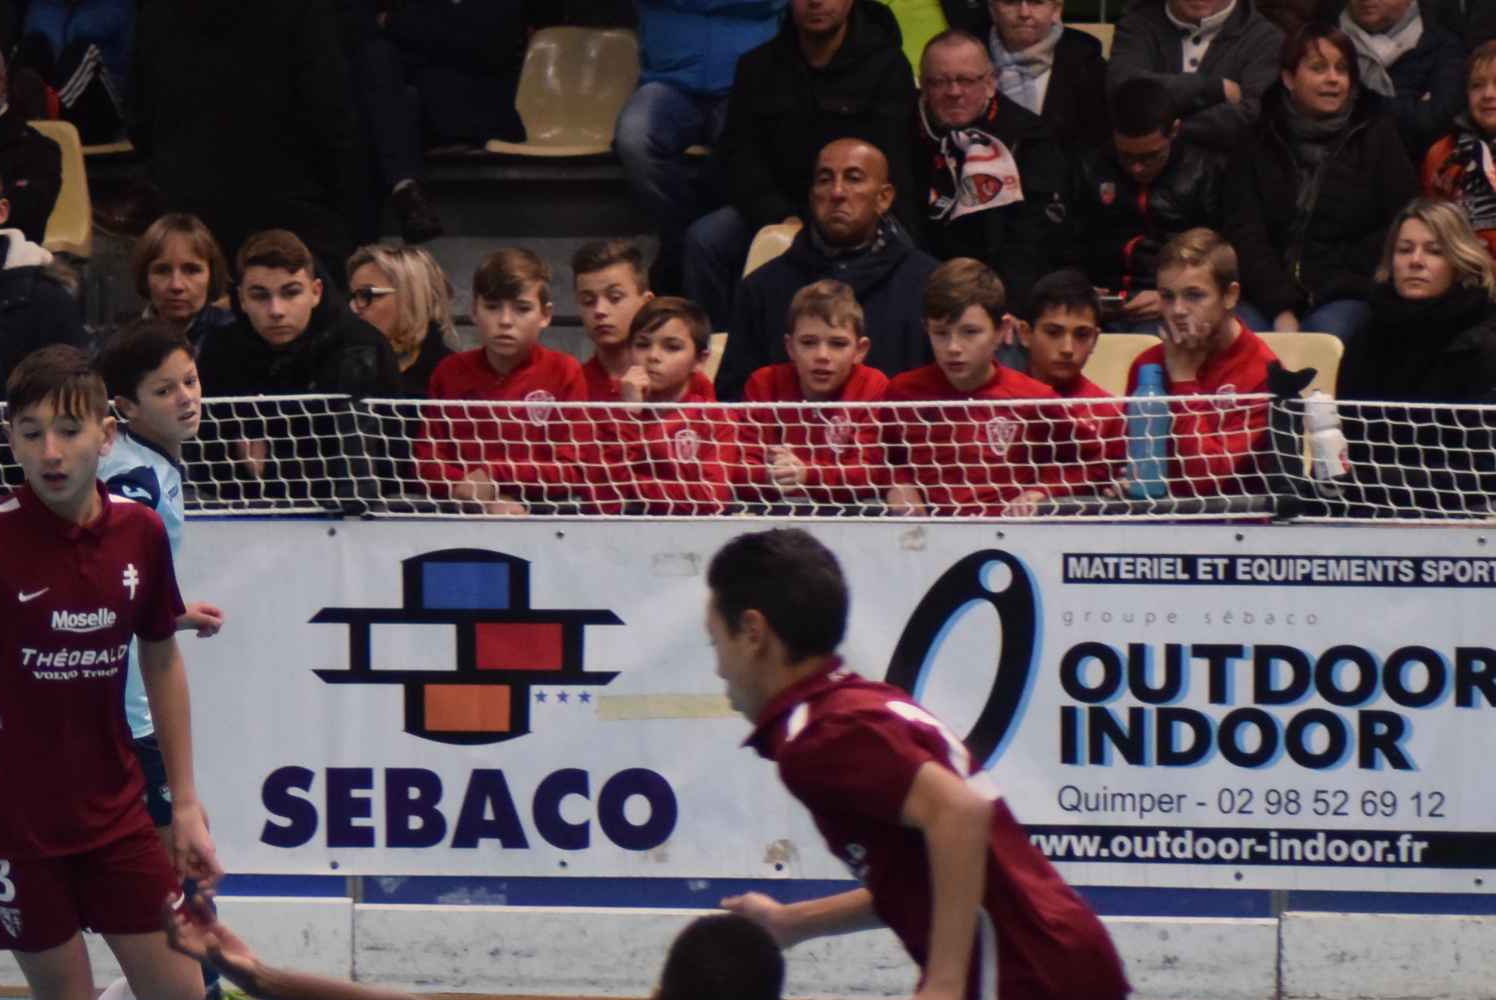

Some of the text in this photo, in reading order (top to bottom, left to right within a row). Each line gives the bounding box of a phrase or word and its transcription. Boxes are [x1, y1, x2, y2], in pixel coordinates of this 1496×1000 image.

[1068, 557, 1190, 580] MATERIEL
[1197, 558, 1229, 581] ET
[1236, 559, 1415, 583] EQUIPEMENTS
[51, 607, 118, 629] Moselle
[1062, 609, 1177, 627] groupe
[1059, 641, 1496, 708] OUTDOOR
[1060, 704, 1418, 771] INDOOR
[260, 766, 679, 851] SEBACO
[1057, 785, 1187, 819] Quimper
[1218, 787, 1253, 815] 02
[1265, 787, 1301, 815] 98
[1312, 788, 1348, 816] 52
[1360, 789, 1398, 817] 69
[1411, 790, 1446, 817] 12
[1030, 831, 1429, 863] ww.outdoor-indoor.fr
